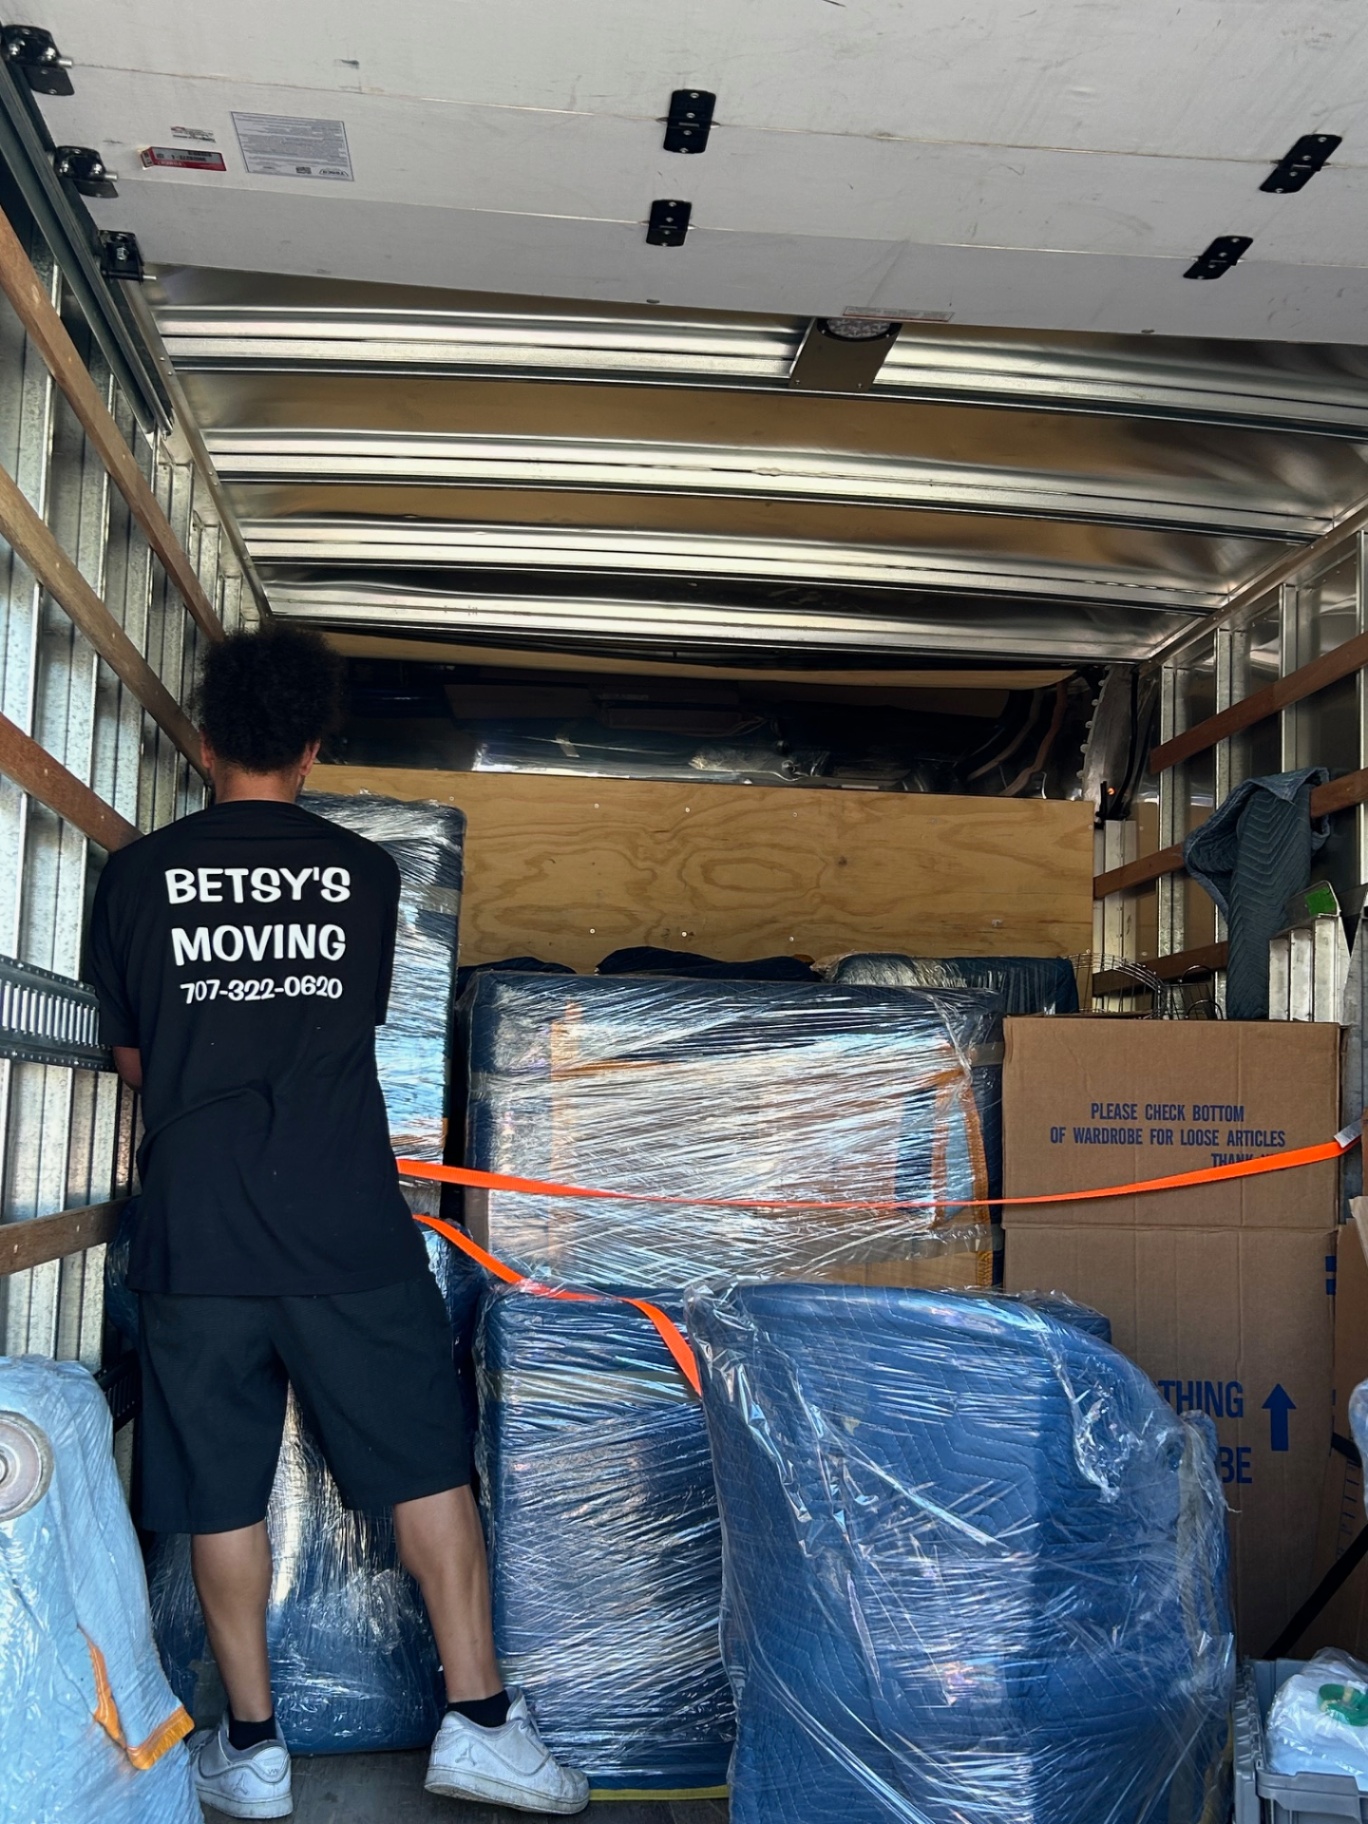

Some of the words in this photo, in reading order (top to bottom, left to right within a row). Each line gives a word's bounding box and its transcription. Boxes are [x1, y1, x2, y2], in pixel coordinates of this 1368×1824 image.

[164, 866, 351, 904] BETSY'S
[171, 924, 346, 966] MOVING
[179, 975, 343, 1004] 707-322-0620
[1090, 1102, 1138, 1120] PLEASE
[1145, 1103, 1186, 1121] CHECK
[1192, 1104, 1246, 1122] BOTTOM
[1049, 1126, 1066, 1144] OF
[1073, 1127, 1143, 1145] WARDROBE
[1149, 1128, 1174, 1146] FOR
[1180, 1129, 1219, 1147] LOOSE
[1227, 1130, 1286, 1148] ARTICLES
[1155, 1380, 1244, 1418] THING
